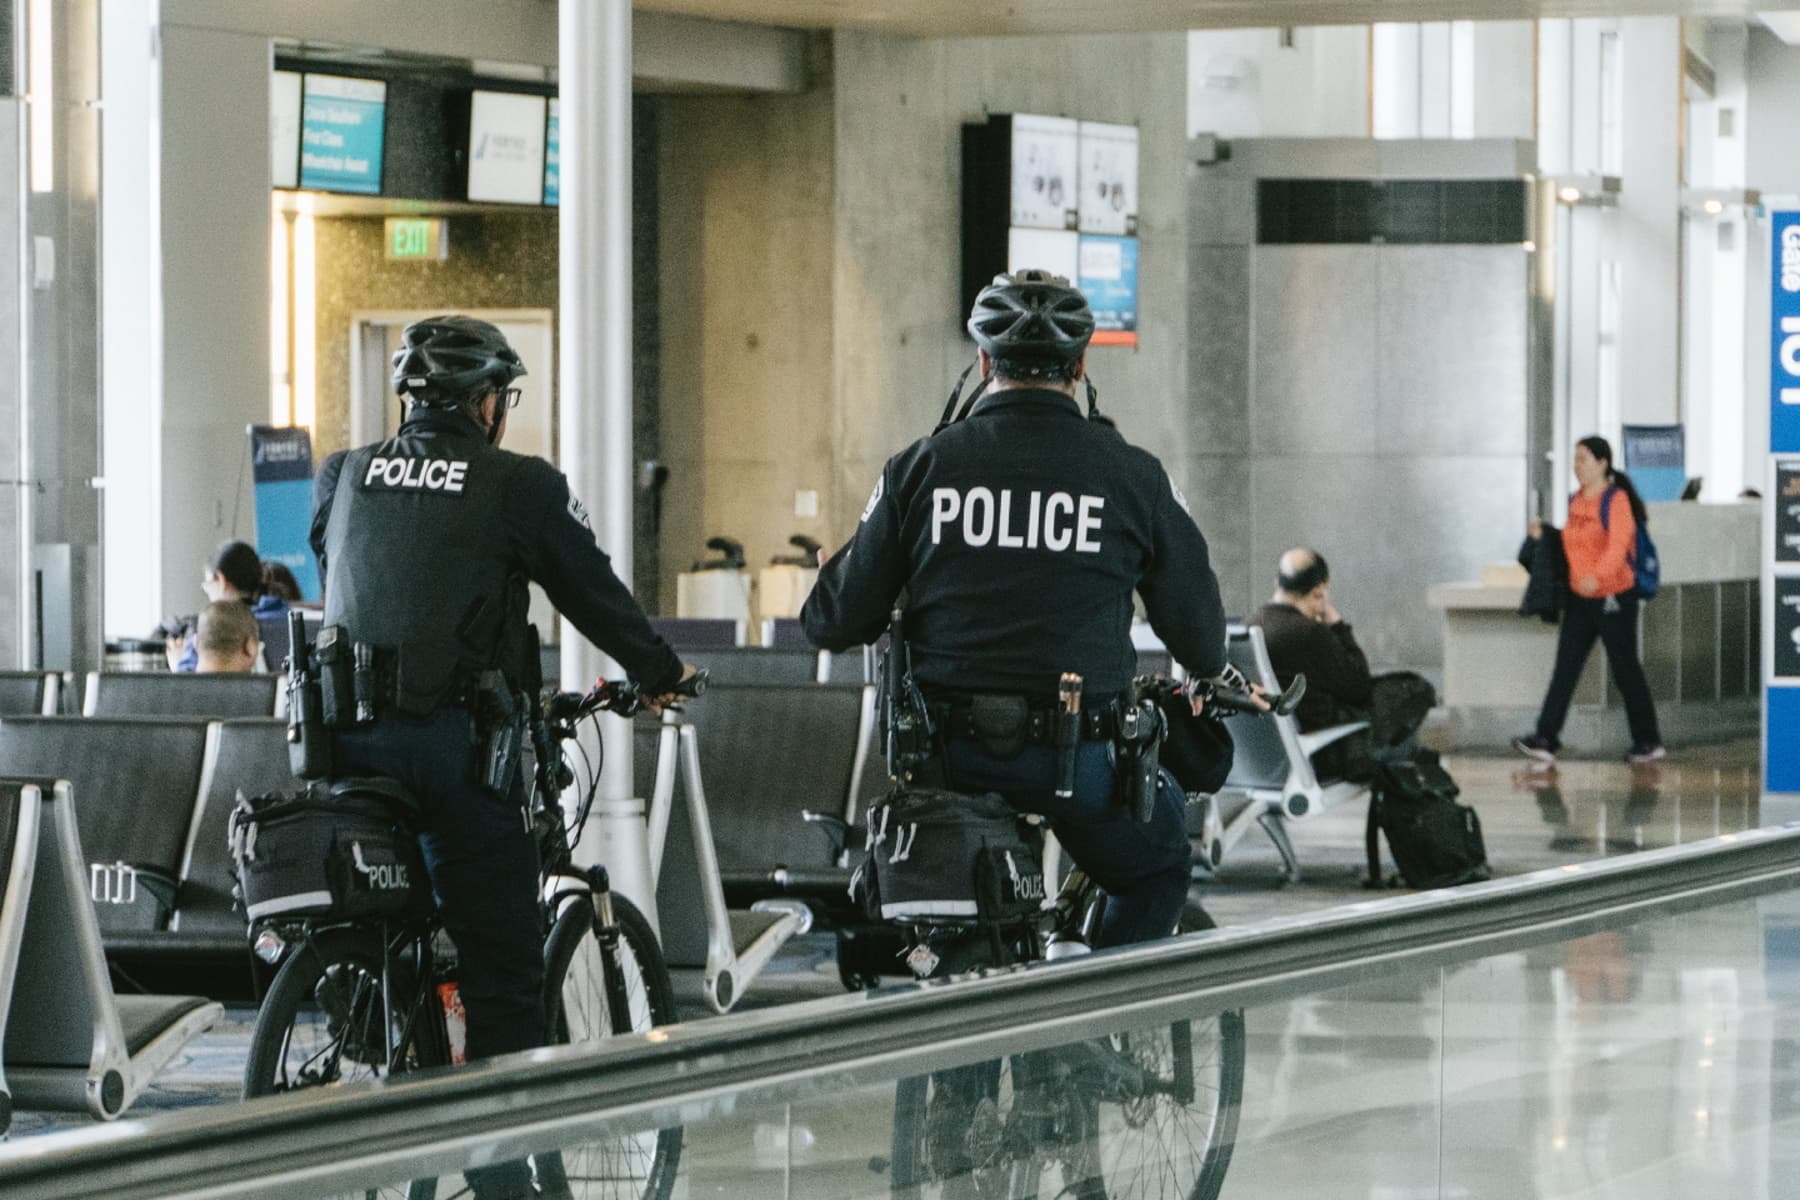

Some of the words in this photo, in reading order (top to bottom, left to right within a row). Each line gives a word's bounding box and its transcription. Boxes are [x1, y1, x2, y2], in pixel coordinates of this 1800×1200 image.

[394, 221, 429, 256] EXIT
[364, 456, 469, 492] POLICE
[931, 486, 1105, 553] POLICE
